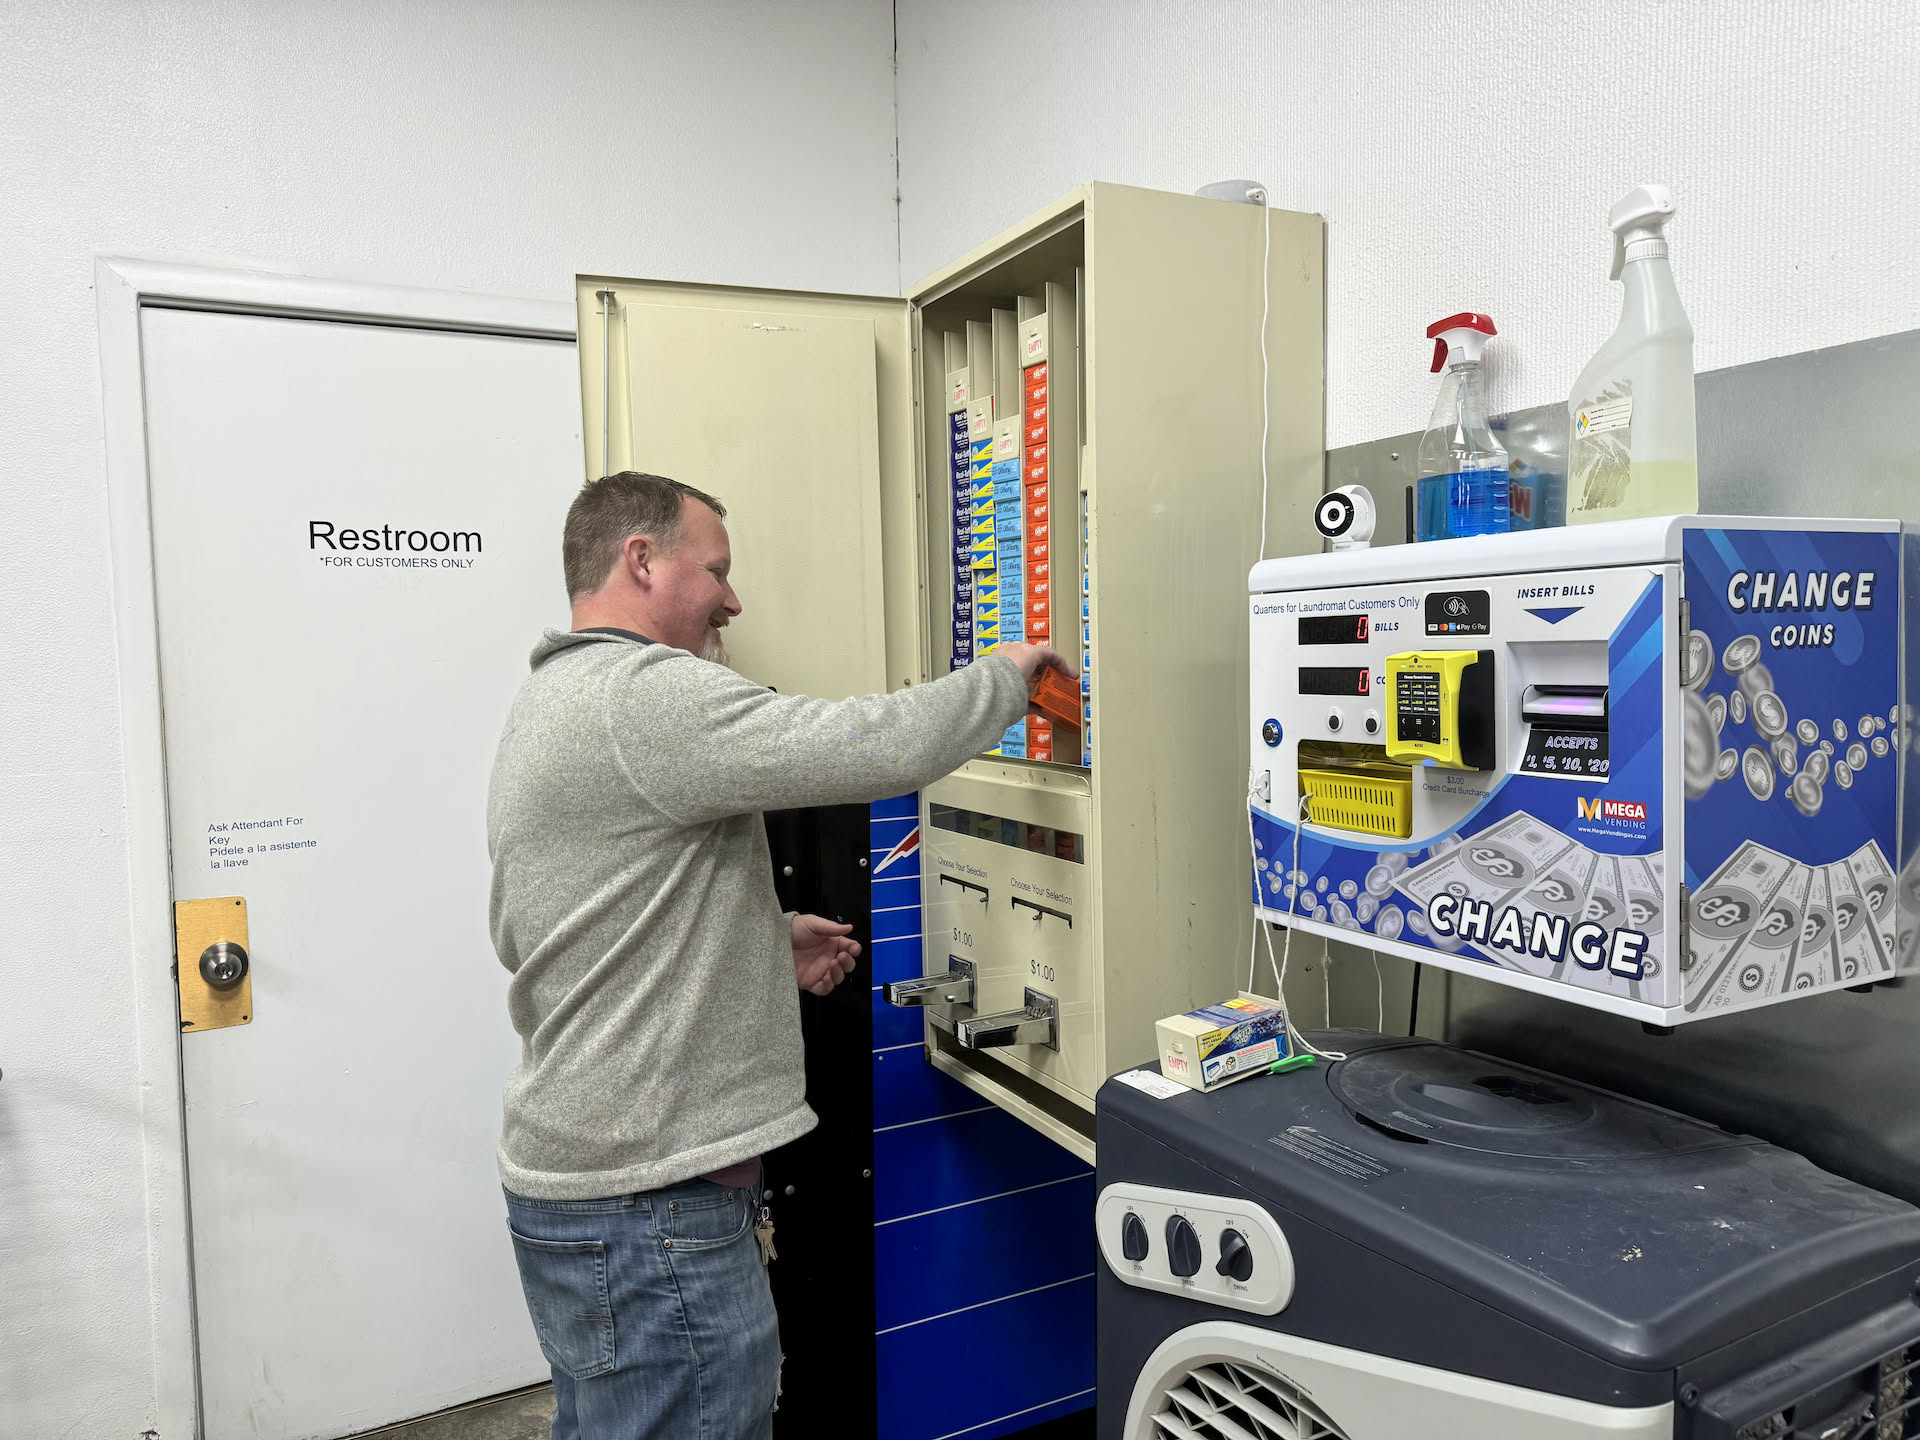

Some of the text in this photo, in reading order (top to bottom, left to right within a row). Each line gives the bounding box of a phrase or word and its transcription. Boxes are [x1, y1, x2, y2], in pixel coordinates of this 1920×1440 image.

[309, 520, 482, 552] Restroom
[356, 557, 438, 568] CUSTOMERS
[441, 558, 474, 568] ONLY
[1517, 584, 1595, 599] INSERT BILLS
[1727, 571, 1875, 609] CHANGE
[1253, 596, 1421, 615] Quarters for Laundromat Customers Only
[1357, 616, 1369, 640] 0
[1374, 622, 1399, 632] BILLS
[1460, 623, 1470, 631] Pay
[1477, 623, 1487, 631] Pay
[1770, 623, 1835, 647] COINS
[1358, 669, 1370, 693] 0
[1545, 736, 1599, 750] ACCEPTS
[1526, 755, 1610, 773] $1, $5, $10, $20
[1422, 783, 1490, 798] Credit Card Surcharge
[1605, 802, 1646, 819] MEGA
[208, 817, 304, 832] Ask Attendant For
[1605, 817, 1646, 830] VENDING
[209, 836, 230, 846] Key
[1577, 826, 1647, 841] www.MegaVendingus.com
[247, 846, 254, 854] a
[257, 844, 267, 853] la
[270, 840, 317, 852] asistente
[210, 858, 249, 869] la llave
[937, 856, 988, 879] Choose Your Selection
[1010, 877, 1073, 905] Choose Your Selection
[952, 927, 973, 947] $1.00
[1429, 893, 1648, 980] CHANGE
[1030, 959, 1055, 982] $1.00
[1167, 1055, 1189, 1073] EMPTY
